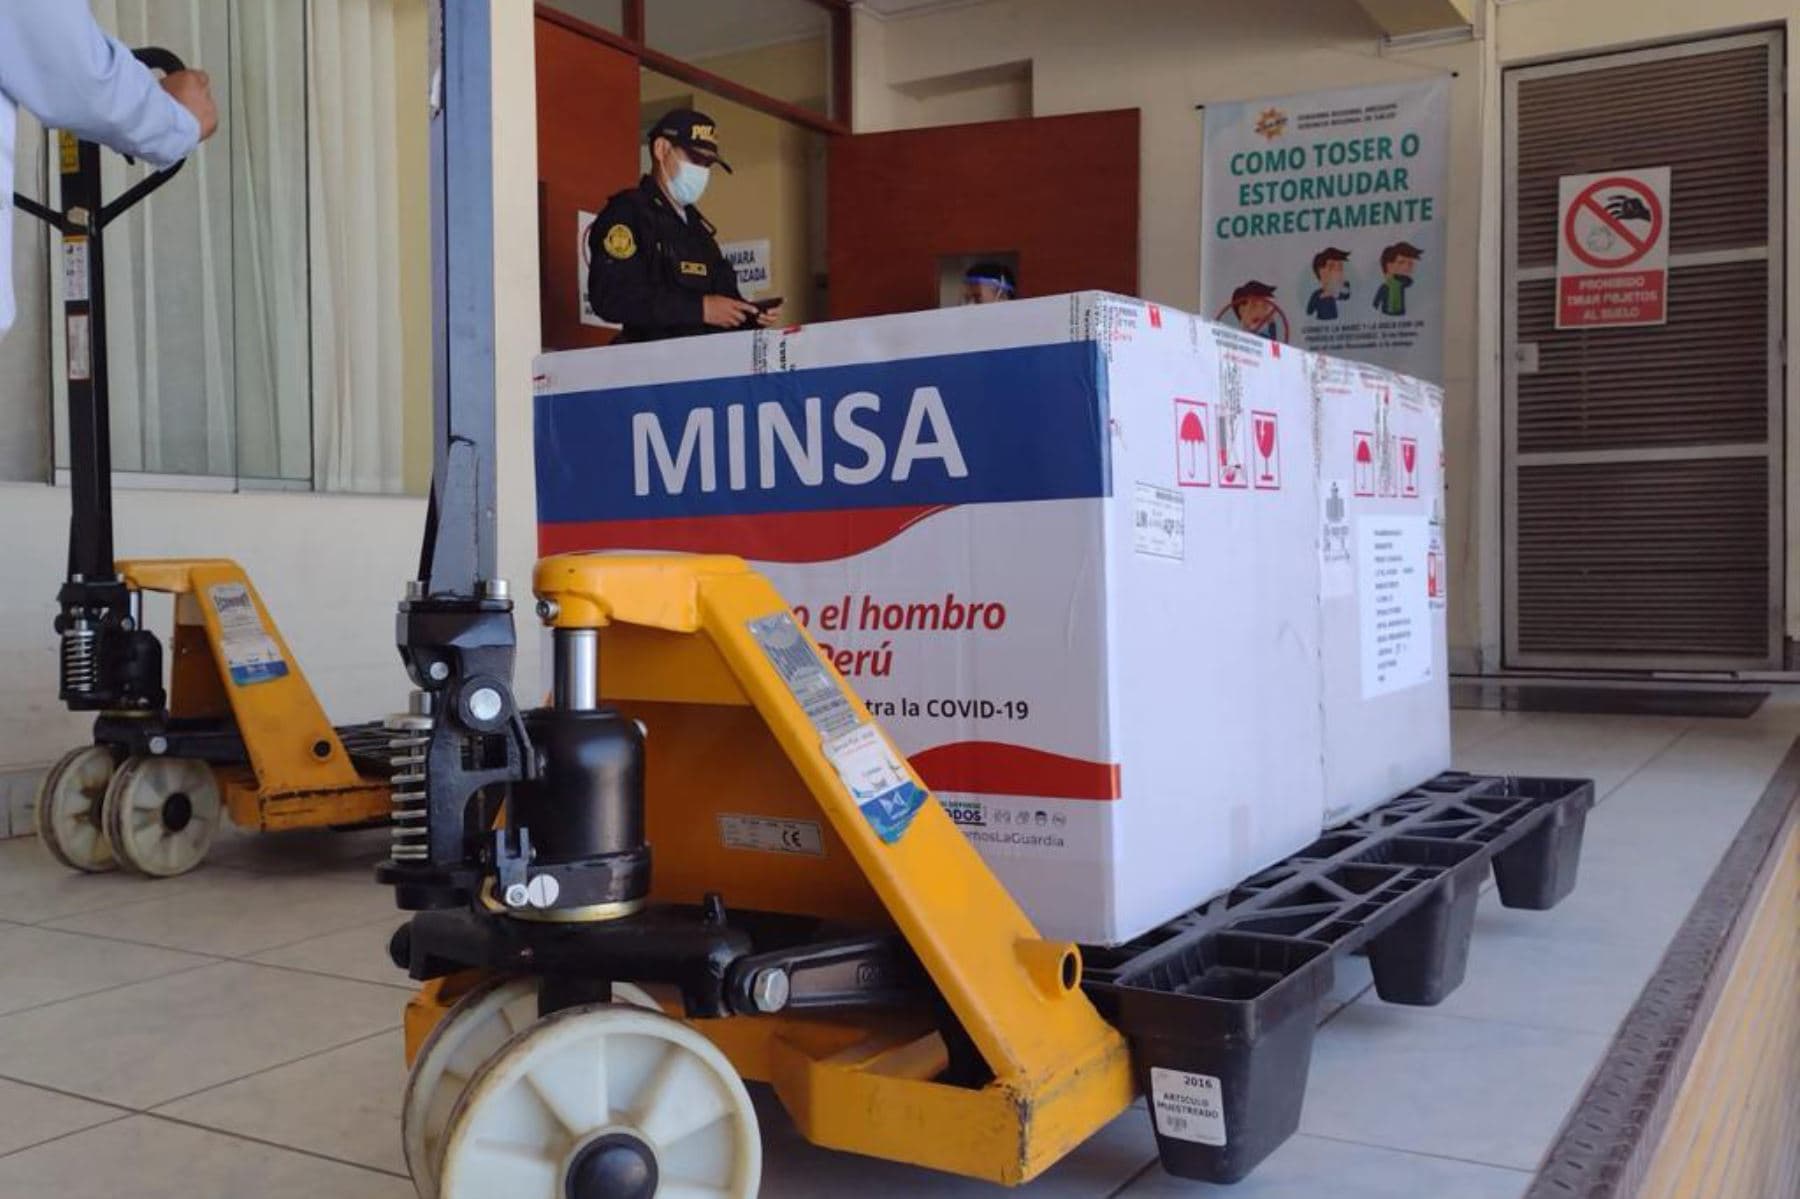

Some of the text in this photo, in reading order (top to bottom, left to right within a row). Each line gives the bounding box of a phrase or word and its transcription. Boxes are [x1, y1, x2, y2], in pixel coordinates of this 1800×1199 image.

[1231, 133, 1421, 177] COMO TOSER O
[1239, 167, 1409, 207] ESTORNUDAR
[1216, 197, 1433, 239] CORRECTAMENTE
[632, 386, 968, 496] MINSA
[820, 595, 852, 631] el
[859, 593, 1006, 632] hombro
[902, 698, 920, 718] la
[927, 699, 1029, 720] COVID-19
[1184, 1075, 1213, 1089] 2016
